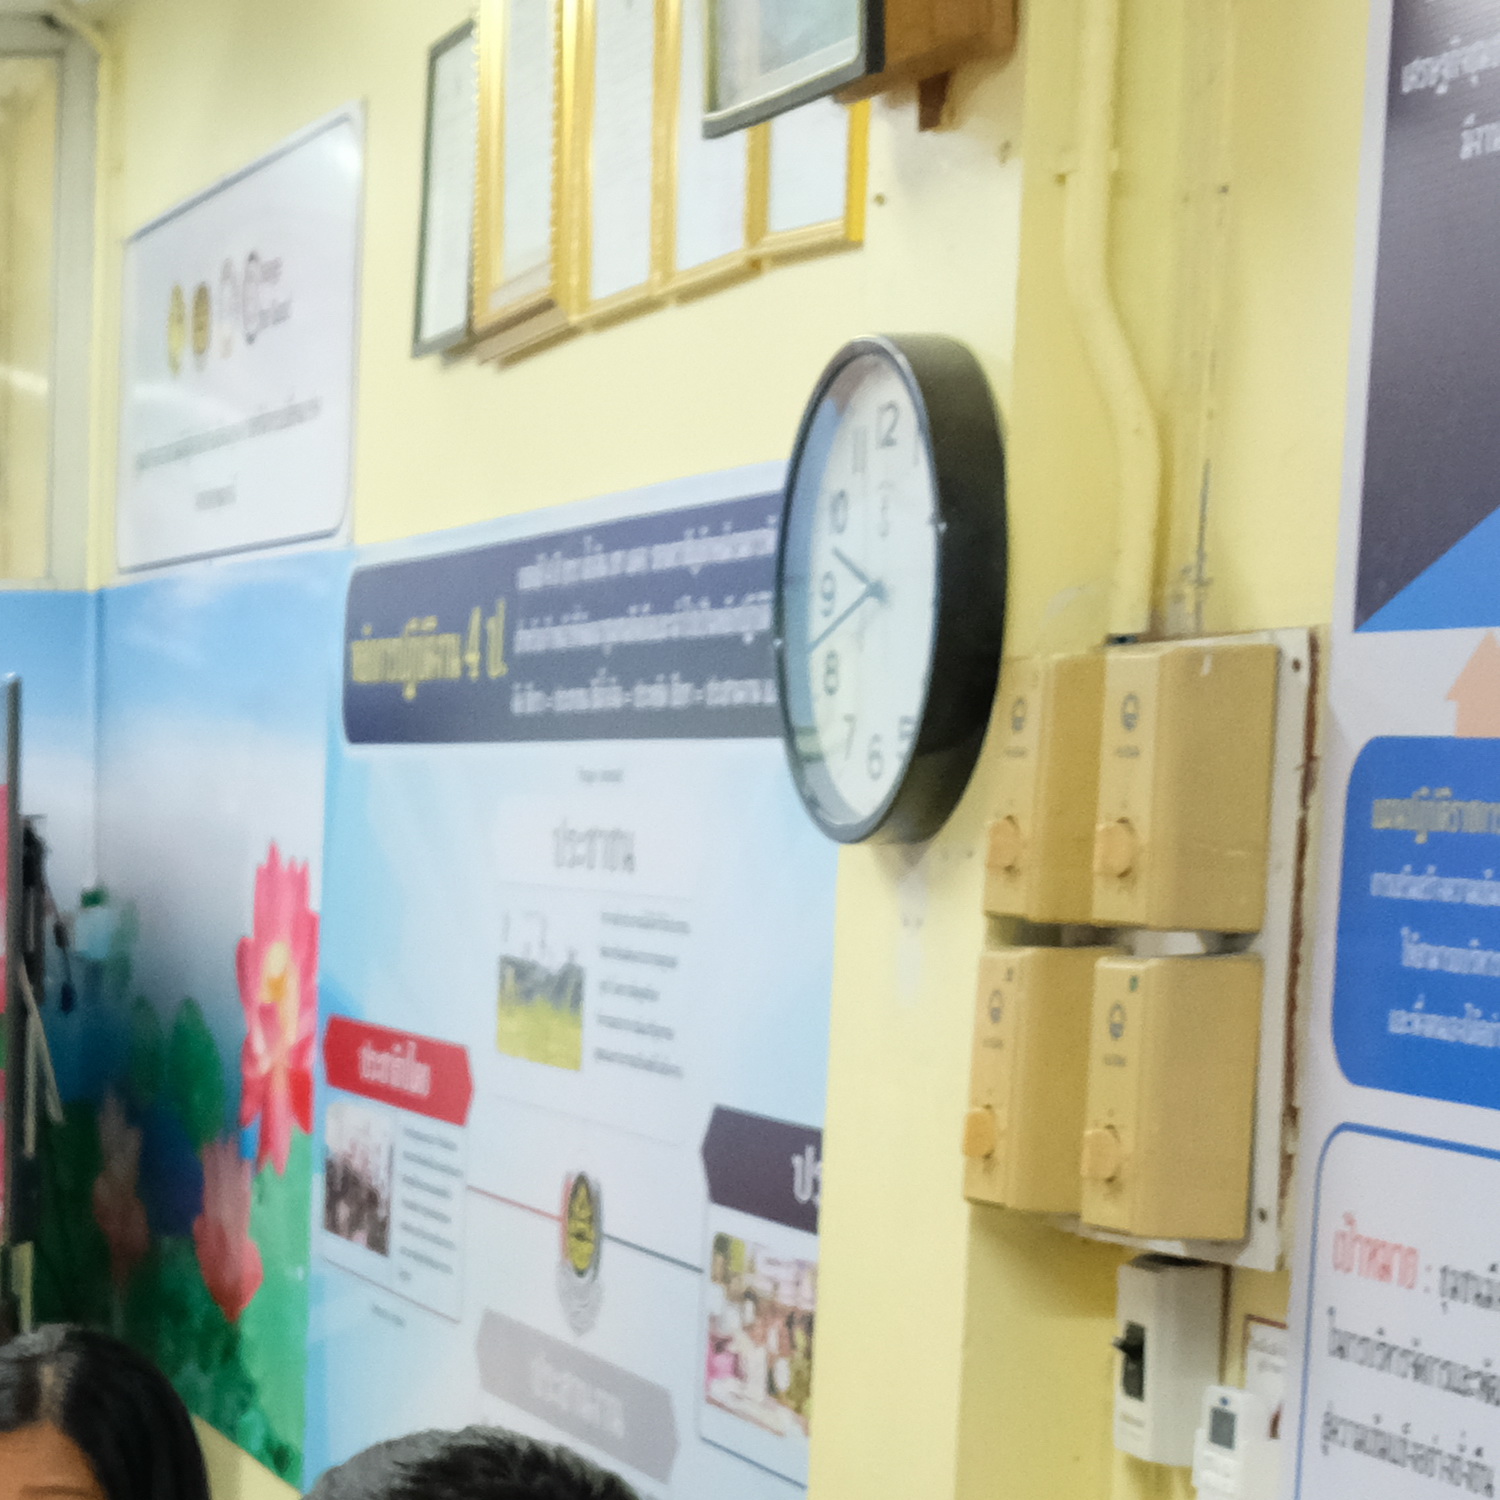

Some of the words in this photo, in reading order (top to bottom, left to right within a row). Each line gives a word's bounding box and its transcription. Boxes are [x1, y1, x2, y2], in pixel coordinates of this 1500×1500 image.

[820, 570, 838, 618] 9
[823, 652, 840, 697] 8
[842, 715, 858, 761] 7
[866, 734, 884, 782] 6
